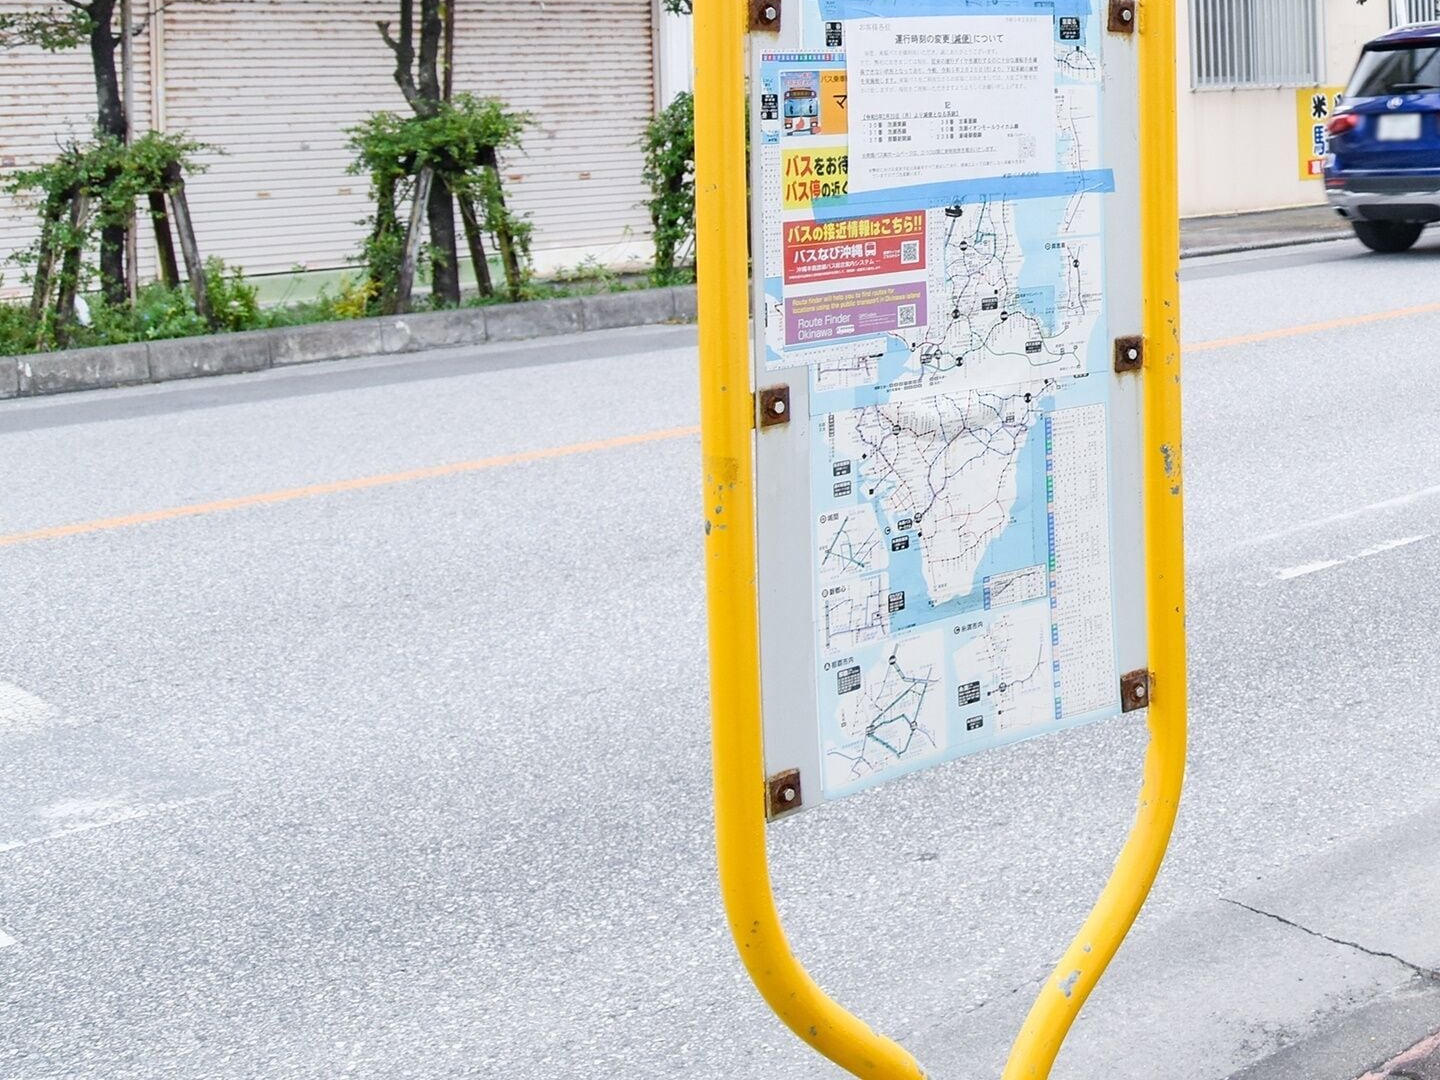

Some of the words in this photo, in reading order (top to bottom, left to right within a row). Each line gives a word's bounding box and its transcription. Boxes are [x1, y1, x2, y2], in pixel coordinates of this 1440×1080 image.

[794, 244, 863, 263] バスなび沖縄
[798, 318, 823, 329] Route
[824, 313, 851, 326] Finder
[797, 327, 833, 340] Okinawa
